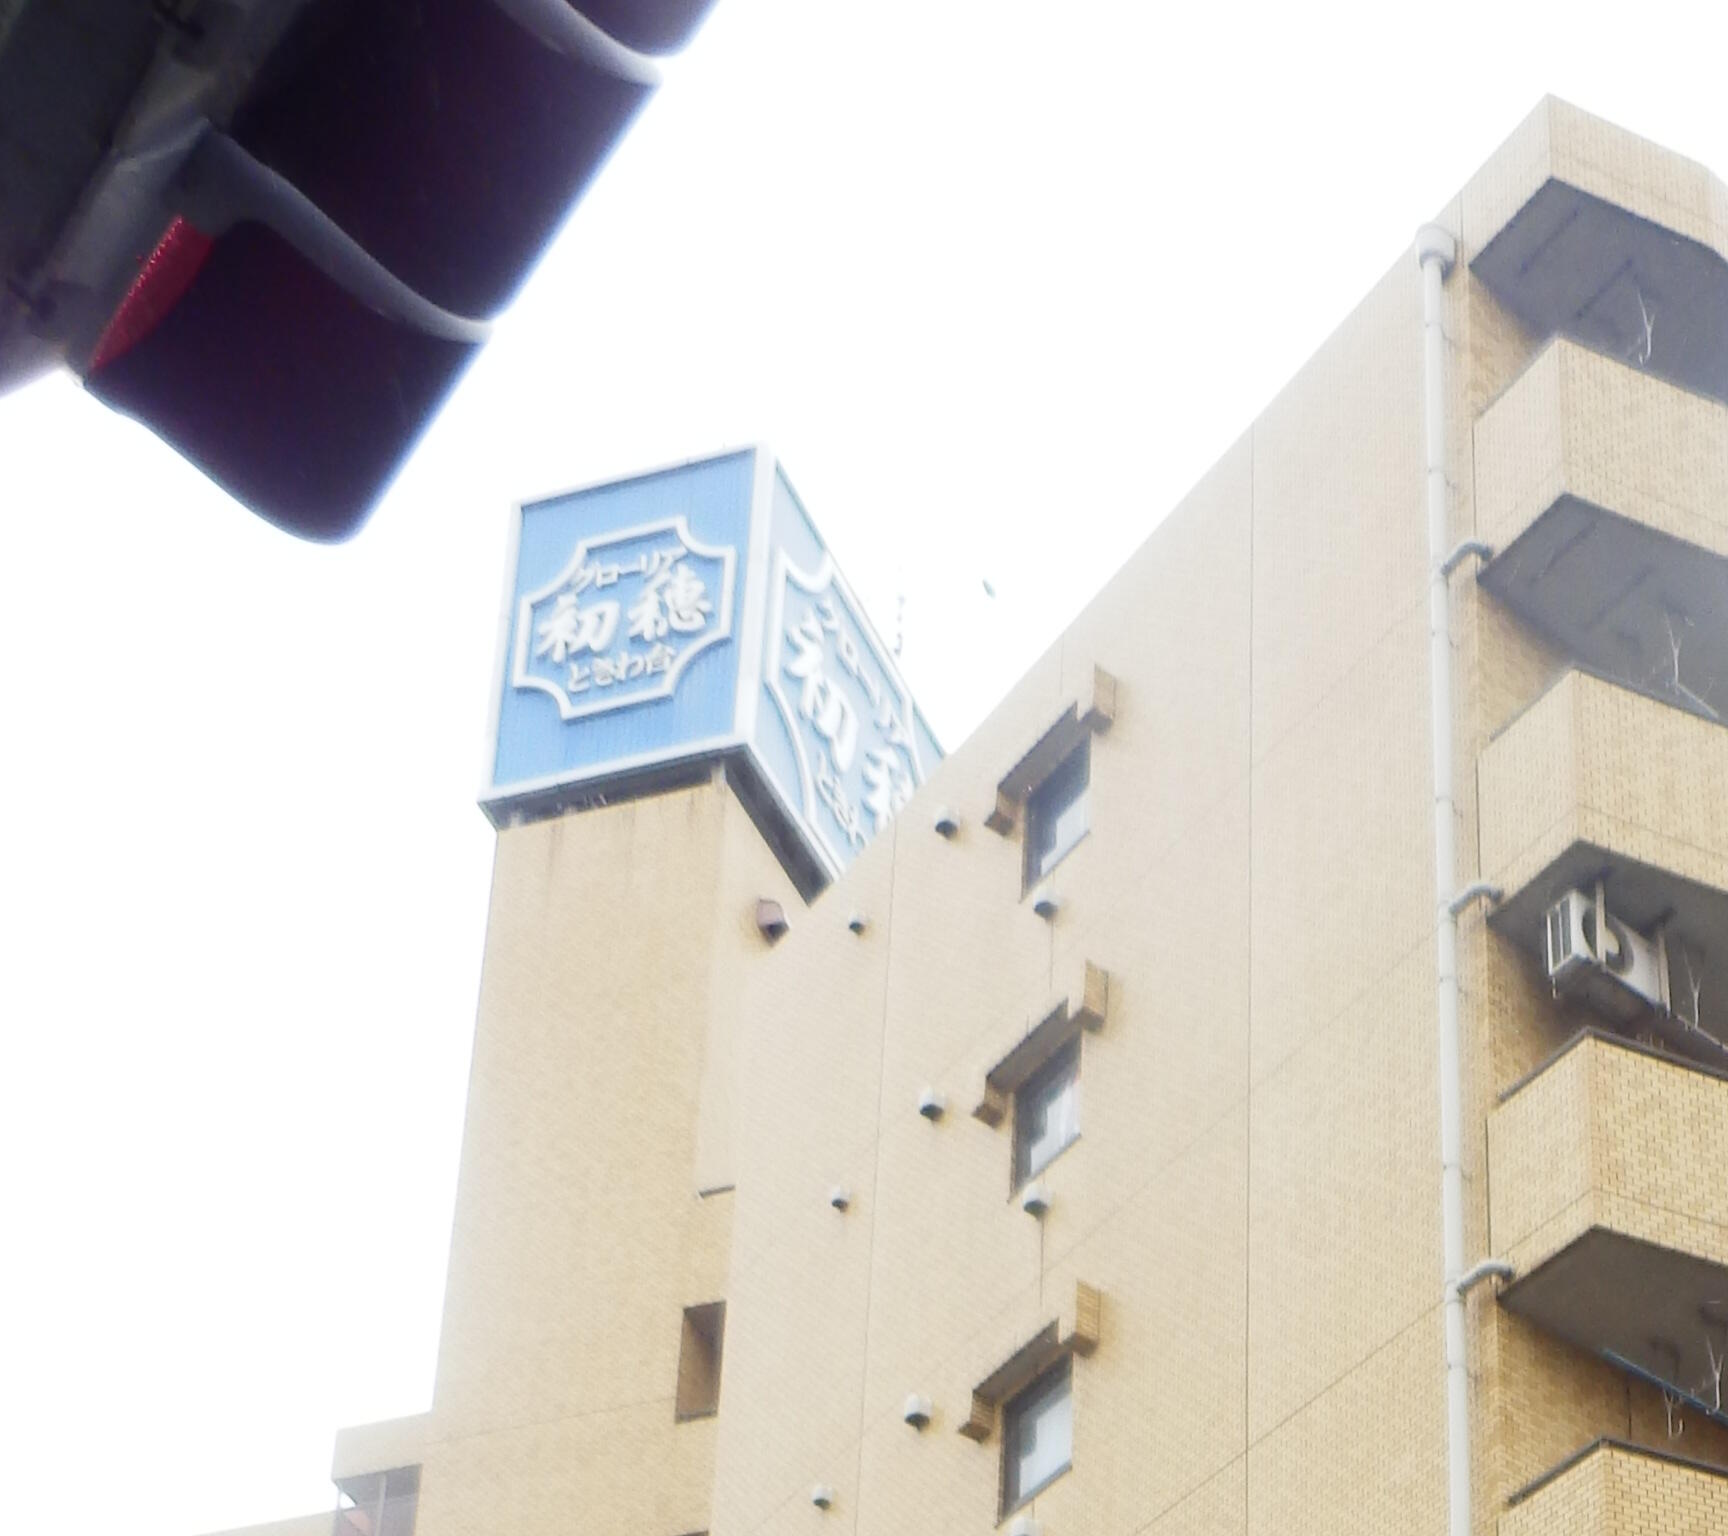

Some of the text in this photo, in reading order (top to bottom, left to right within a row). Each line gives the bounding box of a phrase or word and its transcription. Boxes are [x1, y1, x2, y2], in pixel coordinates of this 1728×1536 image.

[570, 545, 689, 595] グローリア
[536, 563, 713, 663] 初穂
[567, 641, 677, 693] ときわ台
